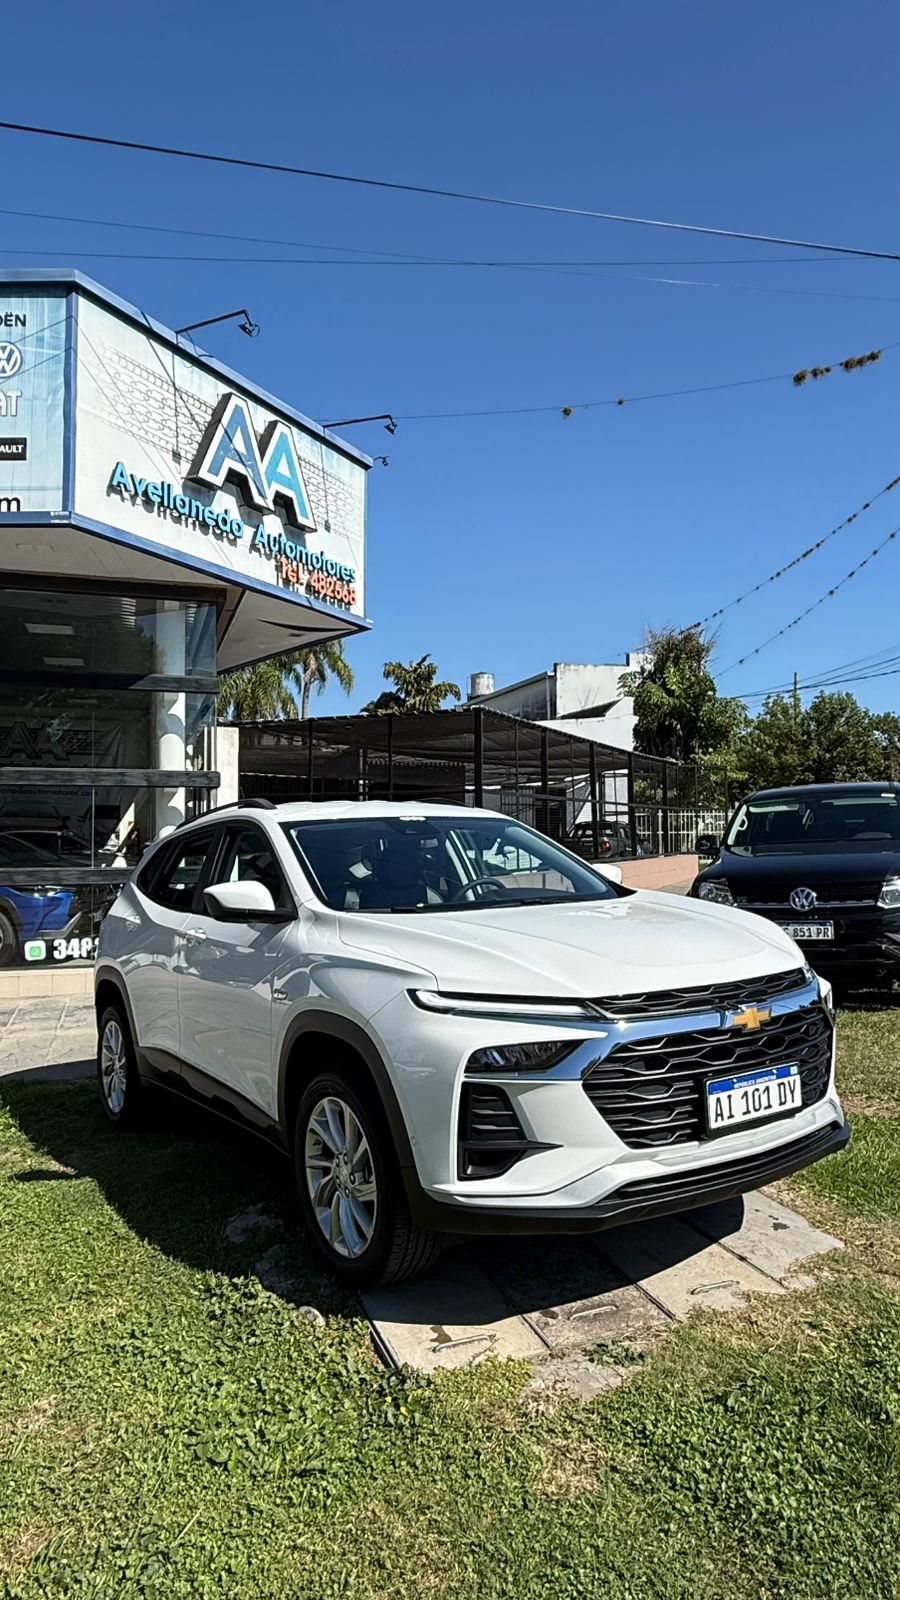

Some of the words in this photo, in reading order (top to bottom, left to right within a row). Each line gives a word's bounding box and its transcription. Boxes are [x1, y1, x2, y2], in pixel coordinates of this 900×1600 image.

[112, 461, 244, 539] Avellaneda
[255, 524, 356, 583] Automotores
[310, 570, 357, 606] 482568
[793, 927, 812, 938] 851
[816, 927, 830, 938] PR
[715, 1094, 735, 1123] AI
[741, 1085, 773, 1116] 101
[777, 1078, 797, 1107] DY
